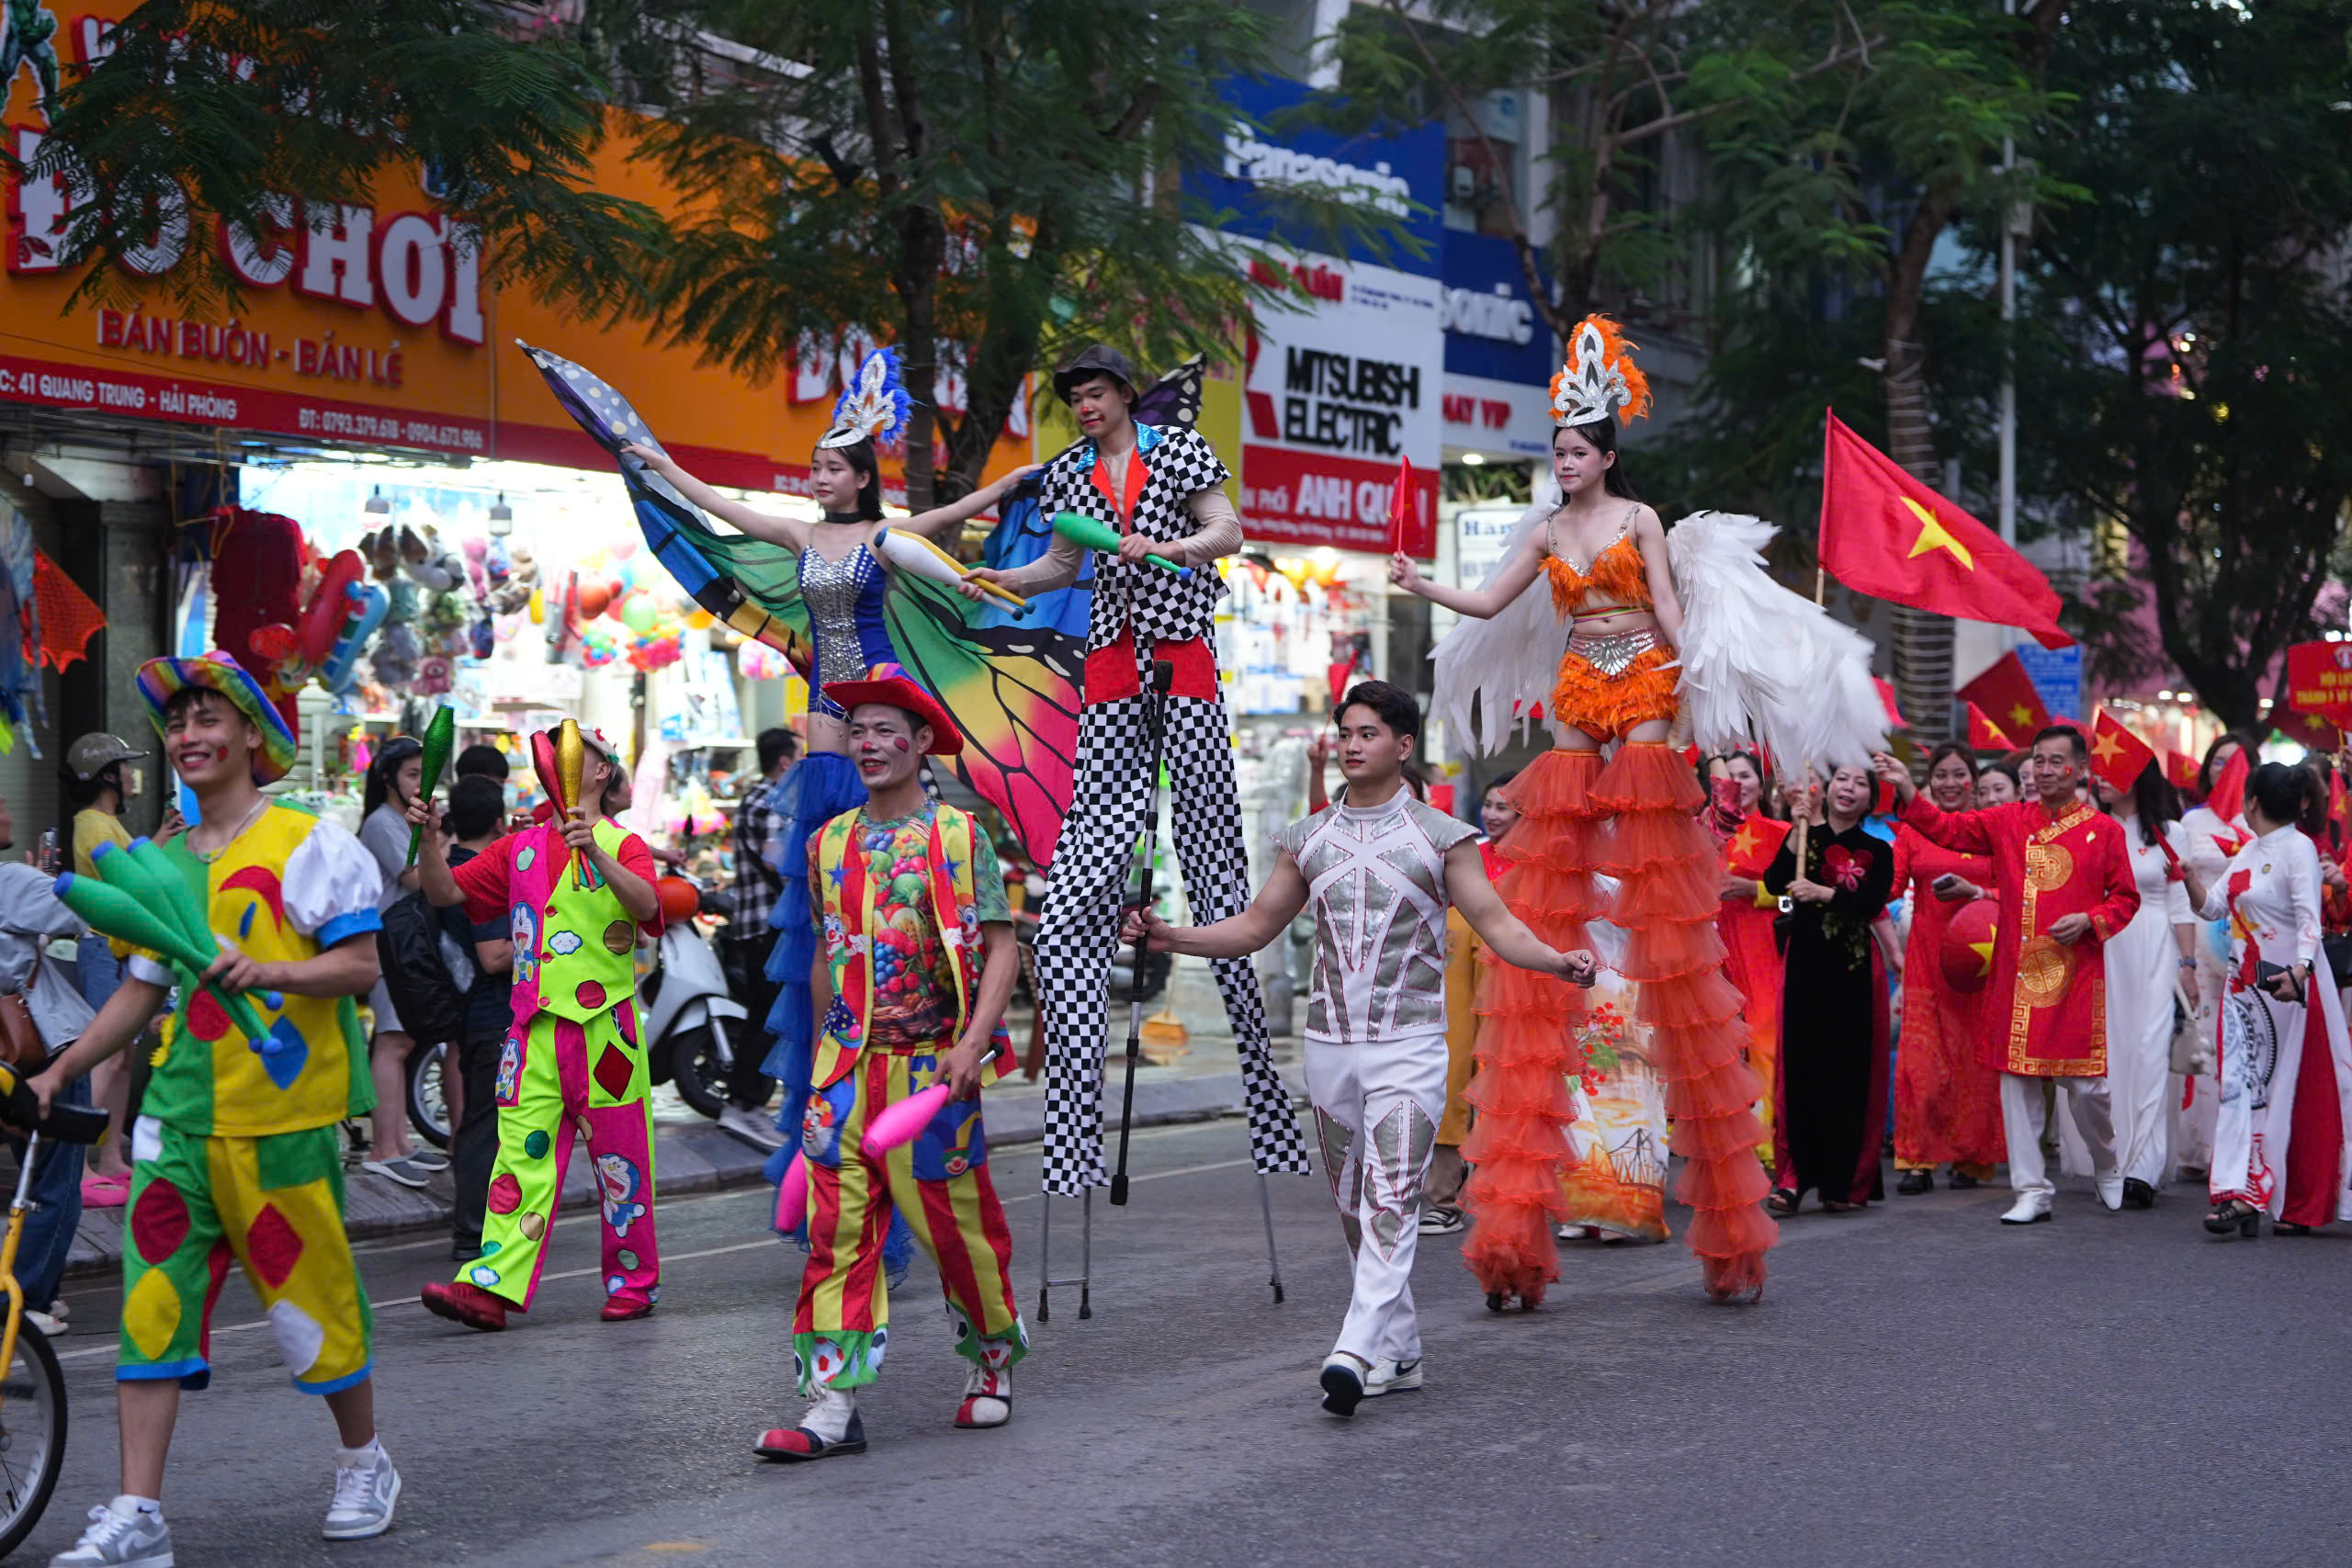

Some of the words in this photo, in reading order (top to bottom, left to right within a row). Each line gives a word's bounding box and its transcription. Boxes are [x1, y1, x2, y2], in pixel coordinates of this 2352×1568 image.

[97, 302, 173, 355] BÁN
[177, 317, 270, 369] BUÔN
[294, 331, 361, 382] BÁN
[40, 376, 94, 403] QUANG
[98, 382, 145, 409] TRUNG
[160, 384, 185, 414] HẢI
[187, 389, 237, 420] PHÒNG
[1284, 396, 1403, 457] ELECTRIC
[1295, 473, 1351, 520] ANH
